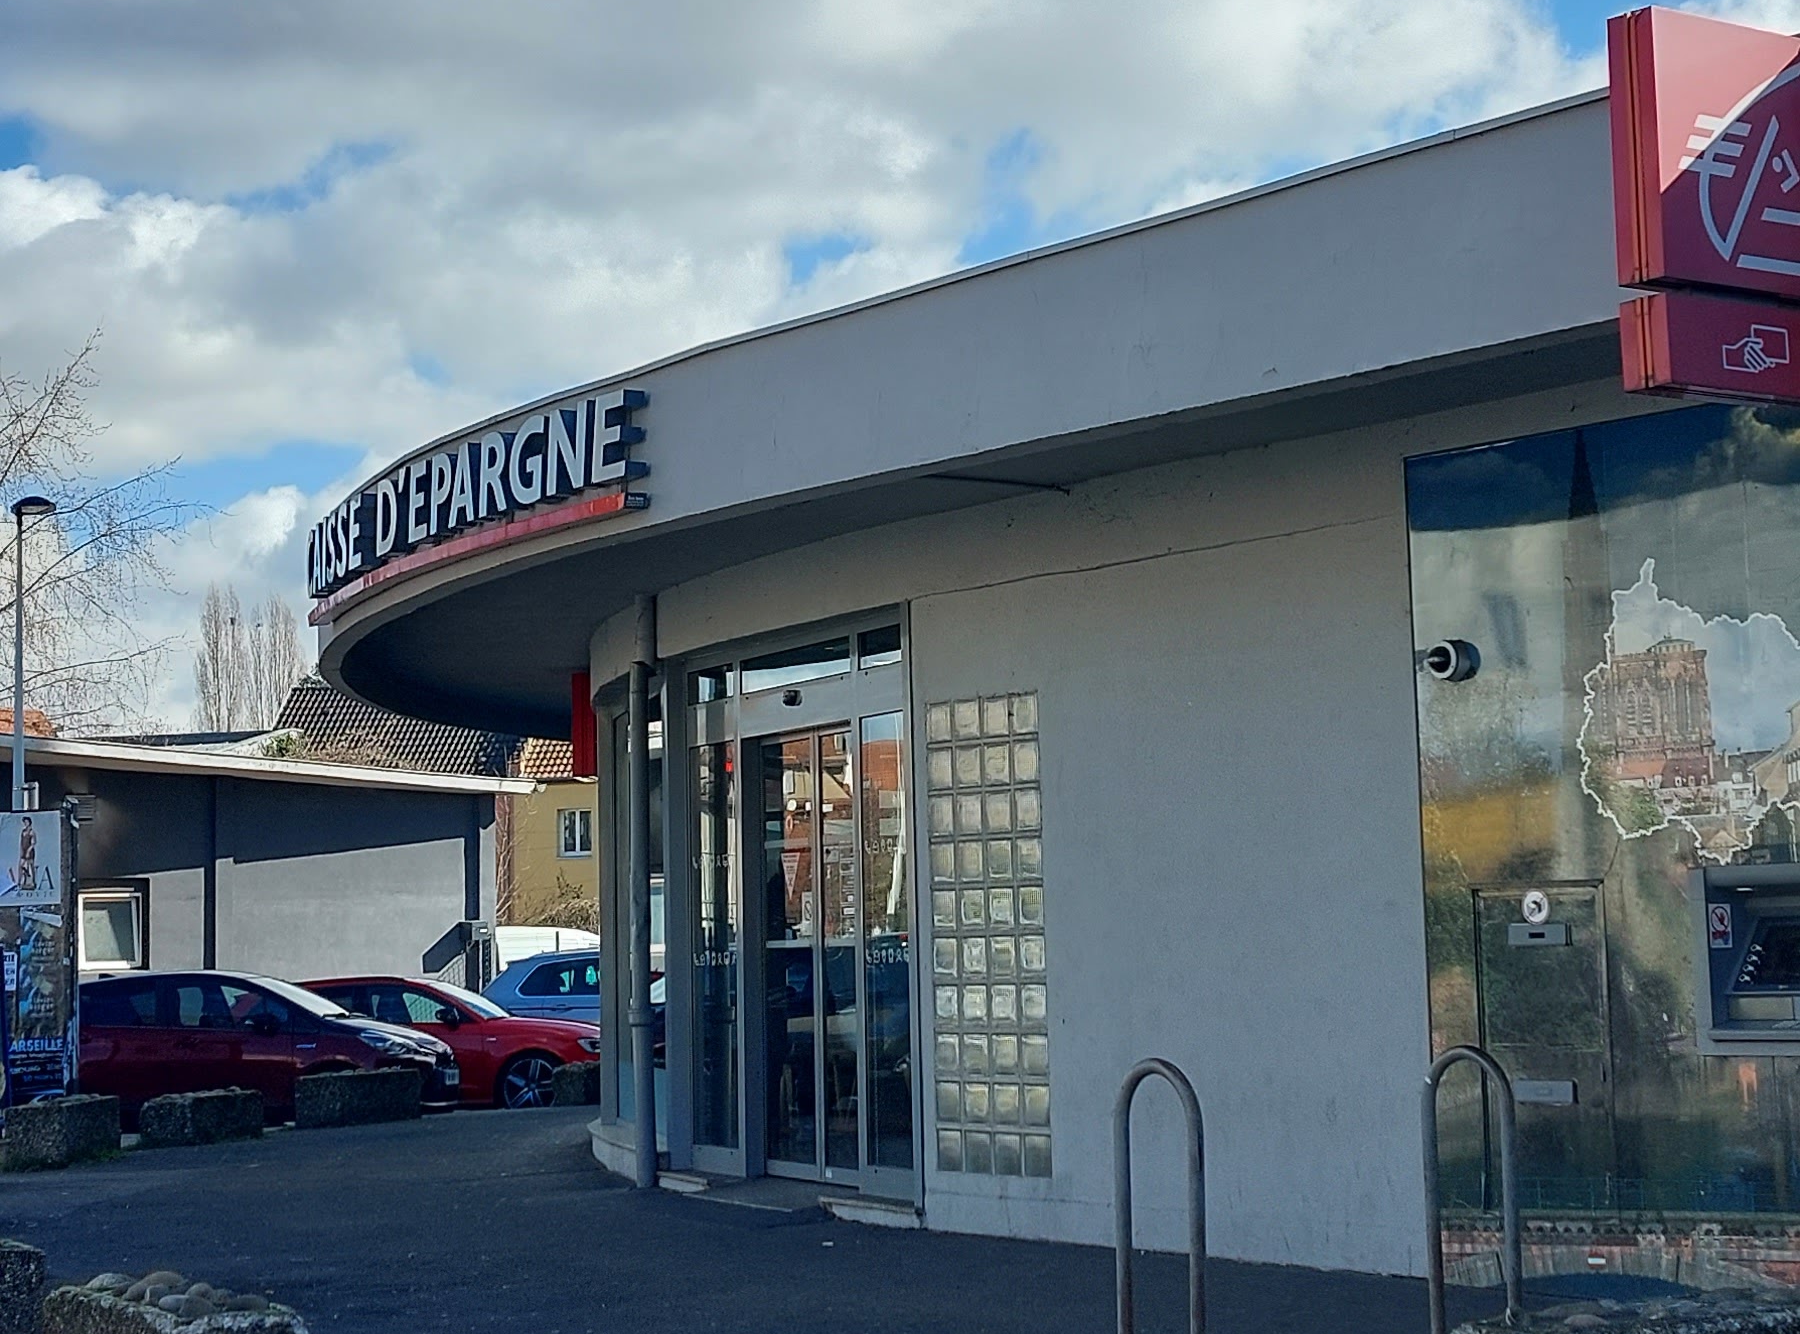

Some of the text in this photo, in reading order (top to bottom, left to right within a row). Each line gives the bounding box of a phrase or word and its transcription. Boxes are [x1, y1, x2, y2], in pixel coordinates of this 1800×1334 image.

[306, 389, 627, 598] CAISSE D'EPARGNE
[9, 1039, 64, 1052] ARSEILLE
